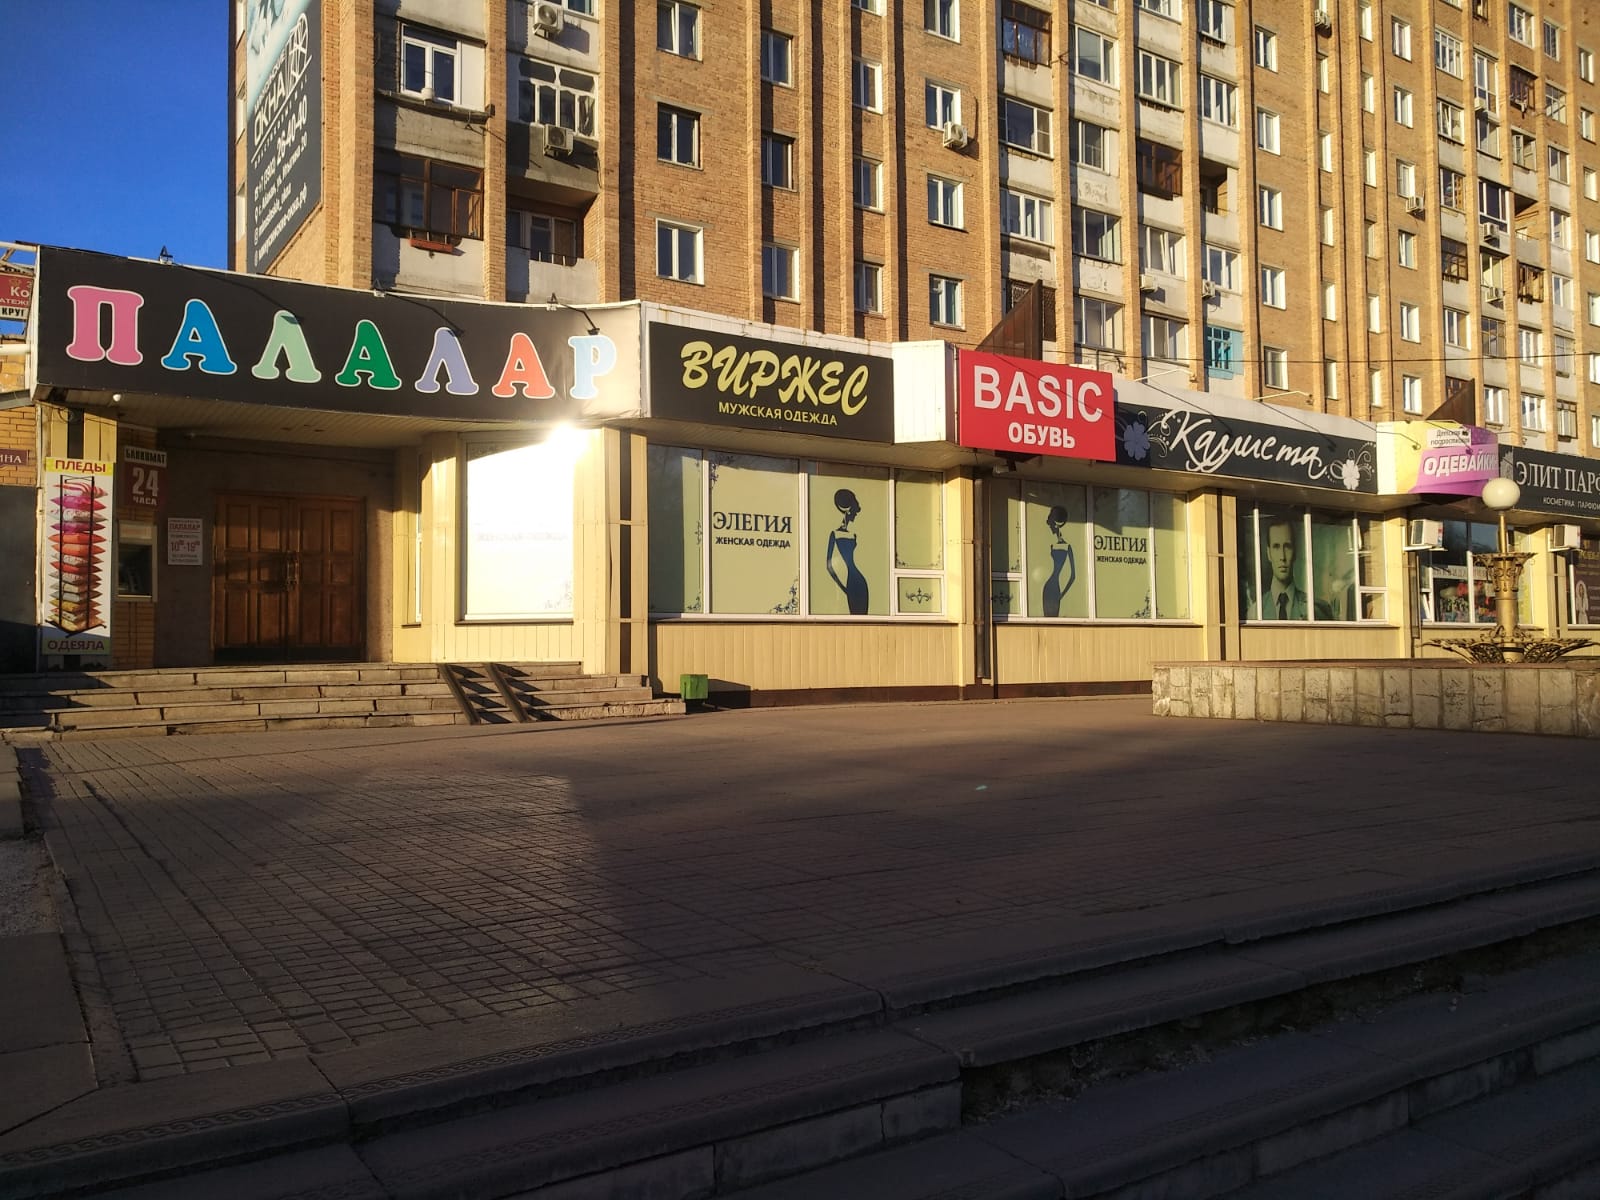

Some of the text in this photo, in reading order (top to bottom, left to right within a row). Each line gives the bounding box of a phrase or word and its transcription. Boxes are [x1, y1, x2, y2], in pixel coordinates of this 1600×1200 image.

[66, 285, 616, 399] ПАЛАЛАР
[680, 341, 869, 416] ВИРЖЕС
[974, 365, 1103, 423] BASIC
[719, 402, 837, 426] МУЖСКАЯ ОДЕЖДА
[1008, 422, 1076, 449] ОБУВЬ
[55, 460, 106, 473] ПЛЕДЫ
[1516, 461, 1561, 489] ЭЛИТ
[132, 467, 159, 497] 24
[713, 511, 792, 533] ЭЛЕГИЯ
[715, 537, 791, 549] ЖЕНСКАЯ ОДЕЖДА
[1094, 535, 1147, 552] ЭЛЕГИЯ
[1096, 556, 1147, 565] ЖЕНСКАЯ ОДЕЖДА
[48, 640, 105, 652] ОДЕЯЛА
